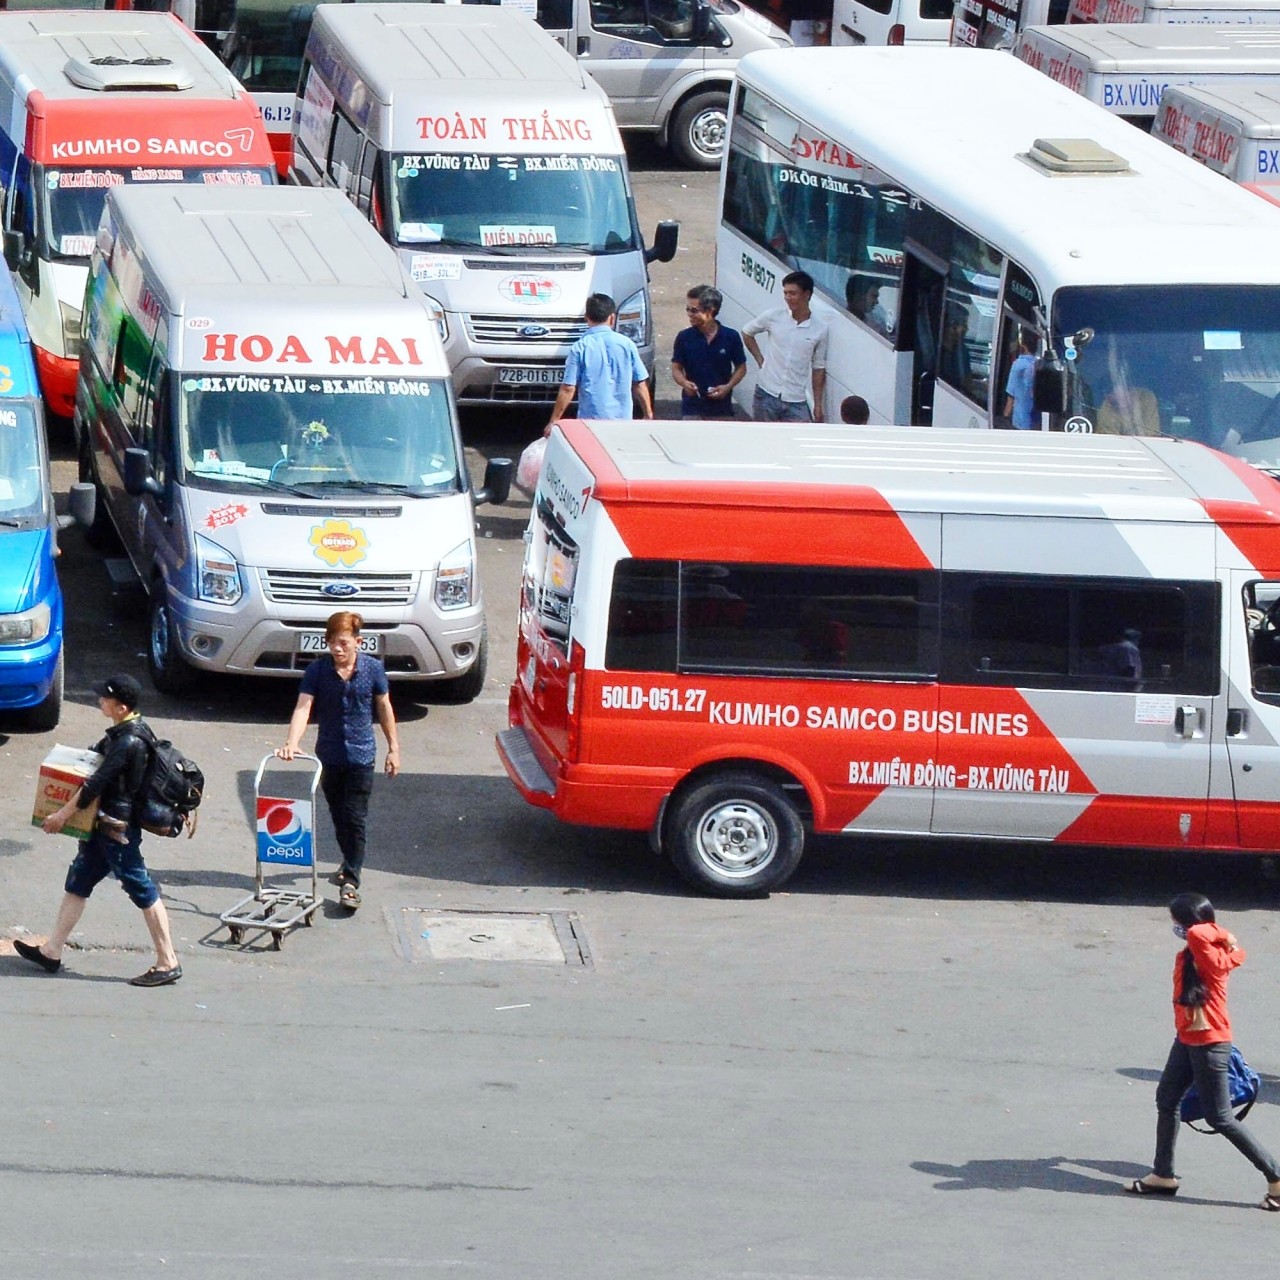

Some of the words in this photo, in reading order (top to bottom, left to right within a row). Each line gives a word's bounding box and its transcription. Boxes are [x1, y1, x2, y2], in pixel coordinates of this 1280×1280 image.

[415, 109, 487, 140] TOÀN
[502, 108, 593, 141] THẮNG
[51, 138, 141, 159] KUMHO
[147, 138, 234, 158] SAMCO
[402, 153, 460, 170] BX.VŨNG
[462, 153, 491, 170] TÀU
[581, 156, 618, 172] ĐÔNG
[202, 333, 313, 364] HOA
[325, 336, 423, 366] MAI
[200, 375, 271, 393] BX.VŨNG
[273, 375, 307, 394] TÀU
[322, 375, 386, 395] BX.MIỀN
[387, 379, 431, 397] ĐÔNG
[1069, 423, 1088, 434] 21
[601, 685, 708, 713] 50LD-051.27
[708, 701, 801, 729] KUMHO
[805, 705, 898, 733] SAMCO
[902, 710, 1030, 738] BUSLINES
[848, 756, 911, 787] BX.MIỀN
[1038, 763, 1070, 794] TÀU
[265, 844, 305, 861] pepsi
